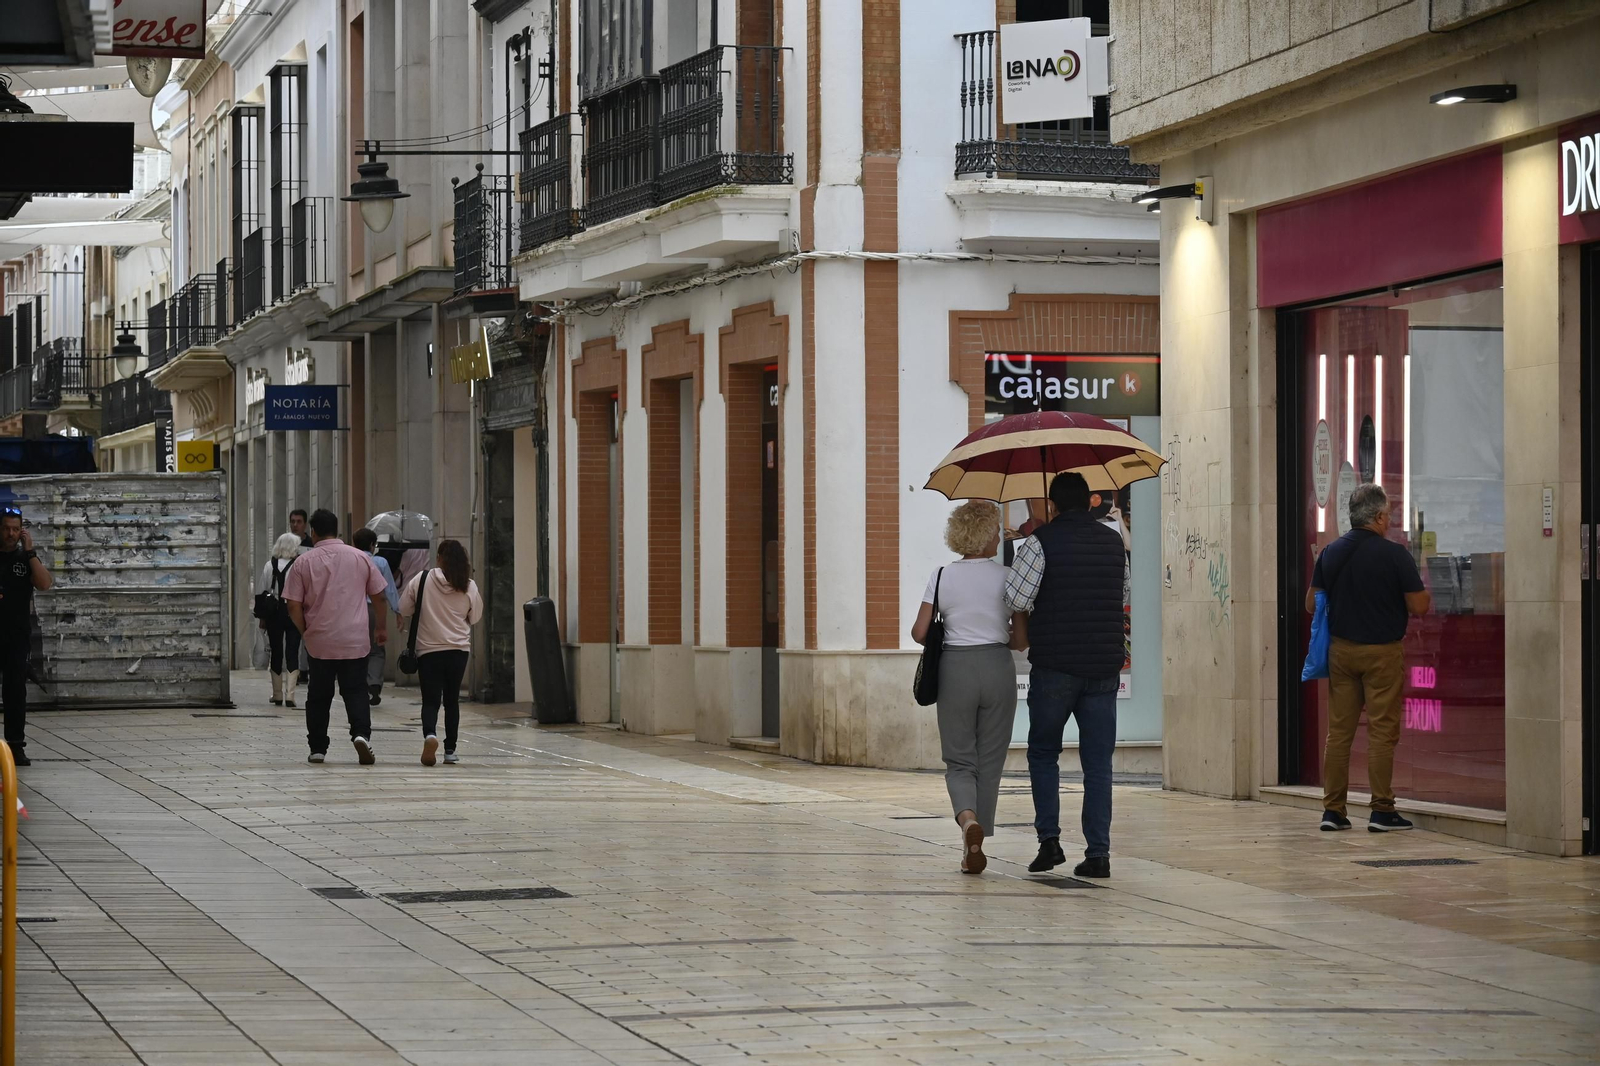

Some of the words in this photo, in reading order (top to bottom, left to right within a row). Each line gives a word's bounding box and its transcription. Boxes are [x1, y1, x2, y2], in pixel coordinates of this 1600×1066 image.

[272, 396, 331, 408] NOTARÍA
[999, 369, 1115, 406] cajasur
[1411, 666, 1436, 689] HELLO
[1405, 697, 1442, 733] DRUNI
